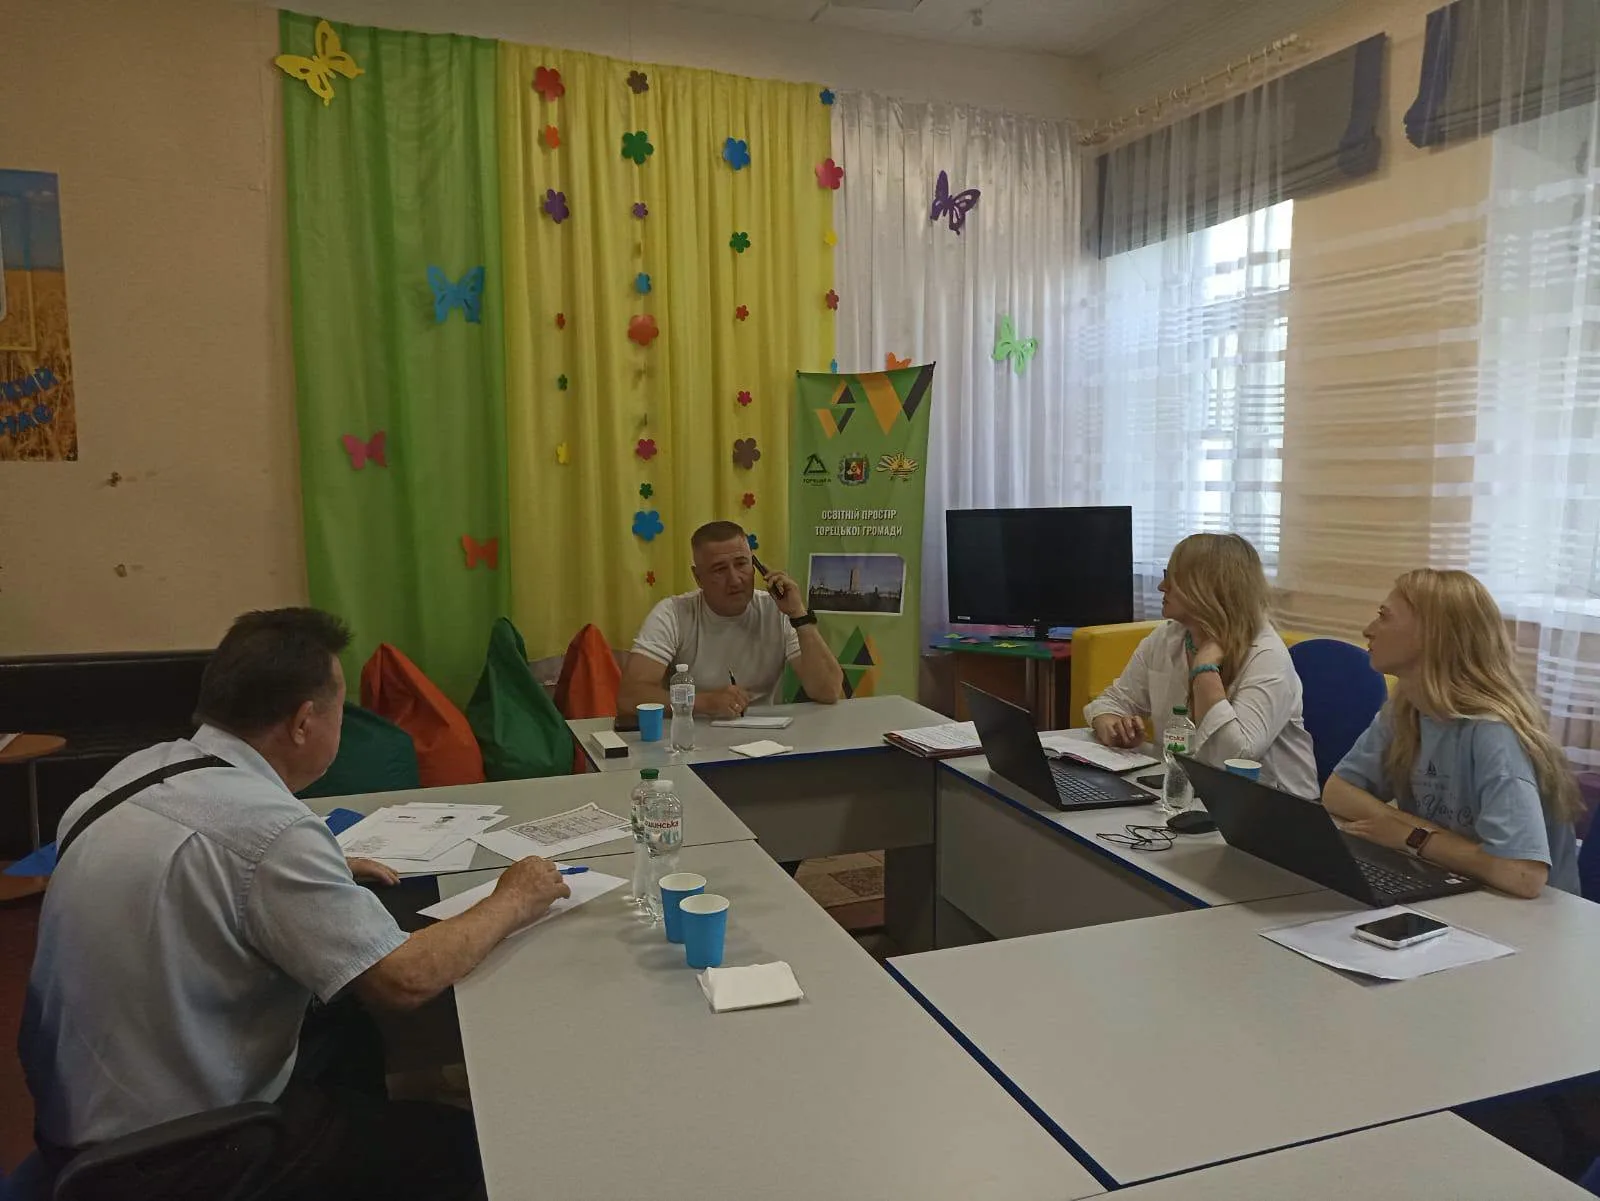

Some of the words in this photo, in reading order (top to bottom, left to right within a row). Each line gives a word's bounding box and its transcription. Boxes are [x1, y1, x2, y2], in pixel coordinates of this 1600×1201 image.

[821, 508, 860, 520] ОСВІТНІЙ
[862, 509, 897, 520] ПРОСТІР
[815, 524, 860, 537] ТОРЕЦЬКОЇ
[862, 525, 903, 537] ГРОМАДИ
